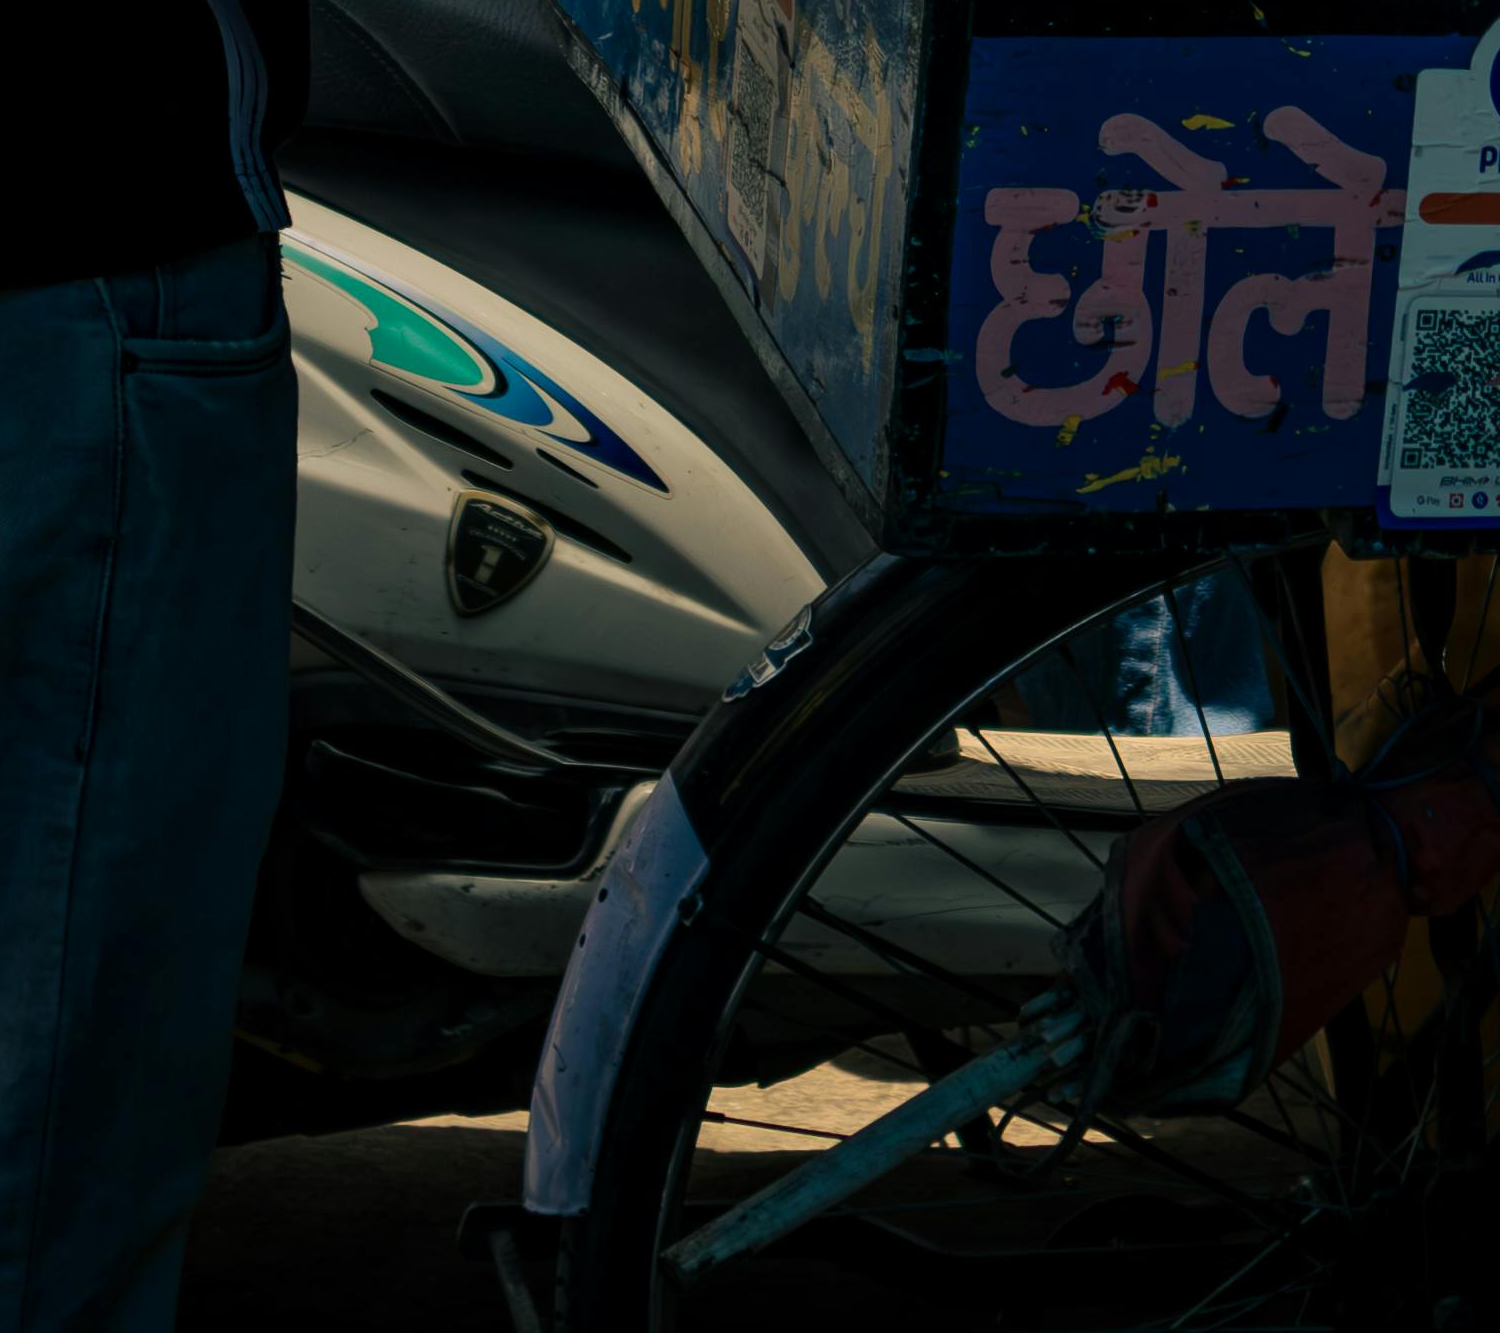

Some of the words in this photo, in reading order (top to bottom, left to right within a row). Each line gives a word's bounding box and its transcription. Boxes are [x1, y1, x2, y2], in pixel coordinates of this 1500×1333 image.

[976, 105, 1404, 427] छोले
[1467, 272, 1483, 283] All
[1485, 273, 1496, 283] In
[1440, 476, 1484, 486] BHIM
